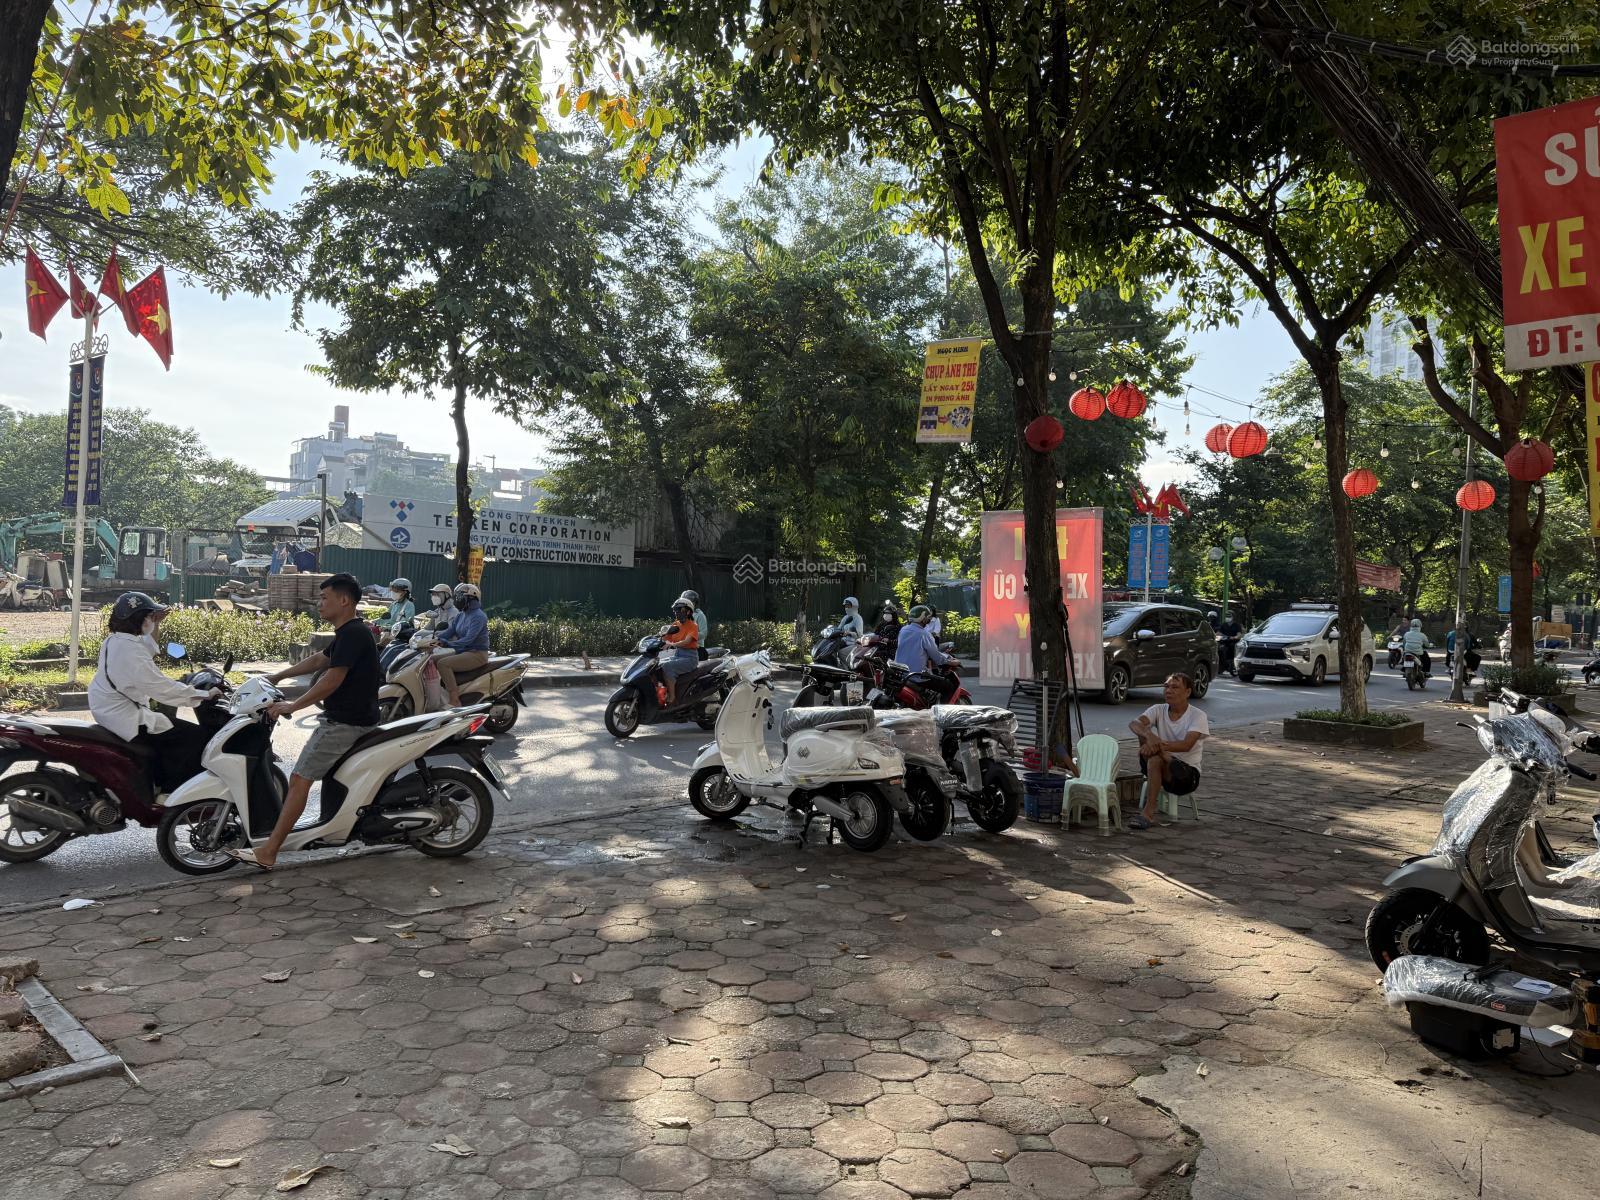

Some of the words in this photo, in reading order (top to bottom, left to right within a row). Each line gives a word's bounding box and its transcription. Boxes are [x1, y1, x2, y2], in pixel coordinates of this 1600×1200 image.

[1517, 215, 1587, 295] XE
[1527, 324, 1584, 358] ĐT:
[925, 364, 945, 381] CHỤP
[945, 358, 962, 378] ẢNH
[962, 356, 977, 377] THẺ
[939, 384, 960, 392] NGAY
[433, 514, 501, 532] TEKEN
[509, 522, 611, 542] CORPORATION
[480, 509, 512, 520] CÔNG
[519, 514, 530, 522] TY
[536, 516, 576, 527] TEKKEN
[501, 546, 577, 562] CONSTRUCTION
[578, 551, 605, 564] WORK
[606, 554, 622, 565] JSC
